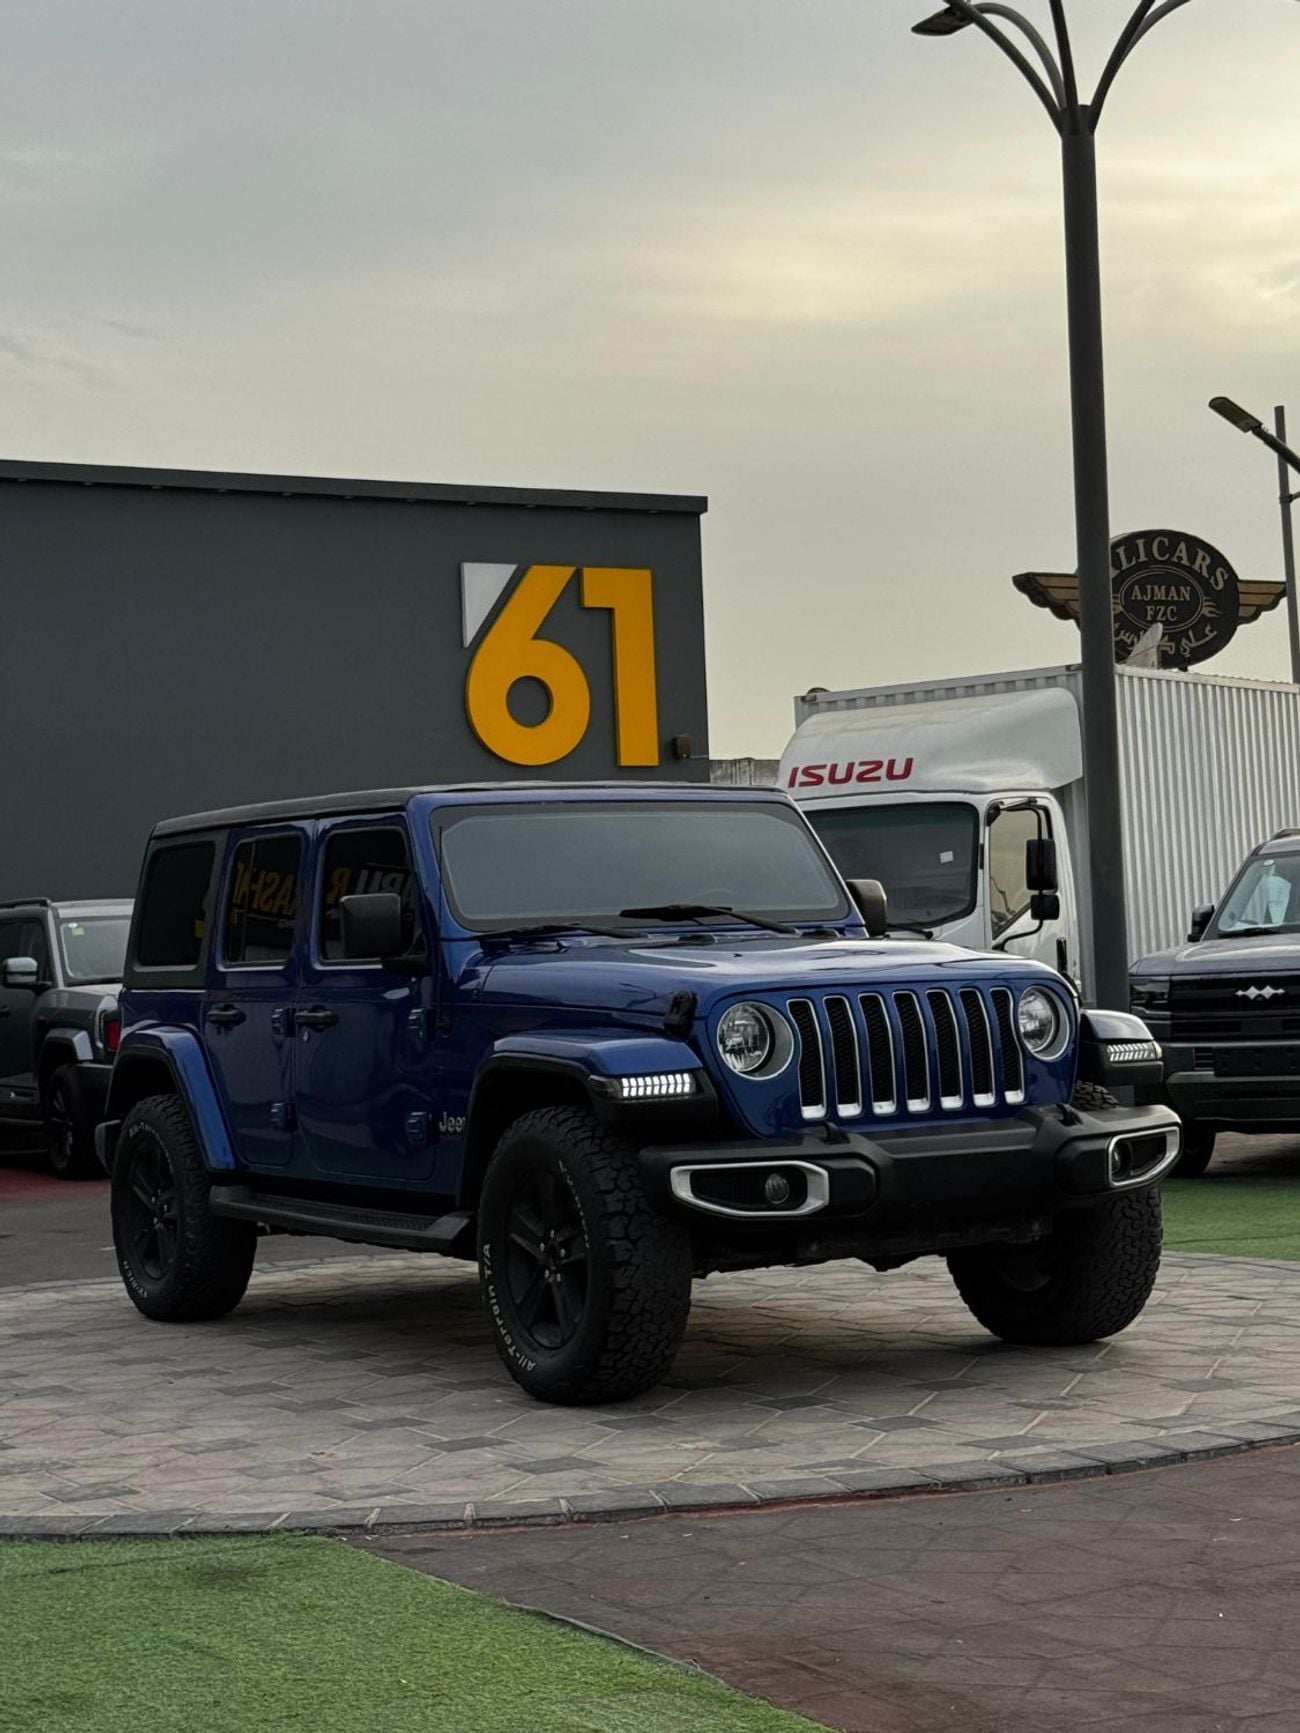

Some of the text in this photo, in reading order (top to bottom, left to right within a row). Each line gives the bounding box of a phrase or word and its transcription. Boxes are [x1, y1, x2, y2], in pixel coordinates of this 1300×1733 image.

[1110, 537, 1229, 591] LICARS
[1131, 584, 1191, 601] AJMAN
[1145, 605, 1177, 621] FZC
[464, 564, 660, 767] 61
[788, 757, 914, 788] ISUZU
